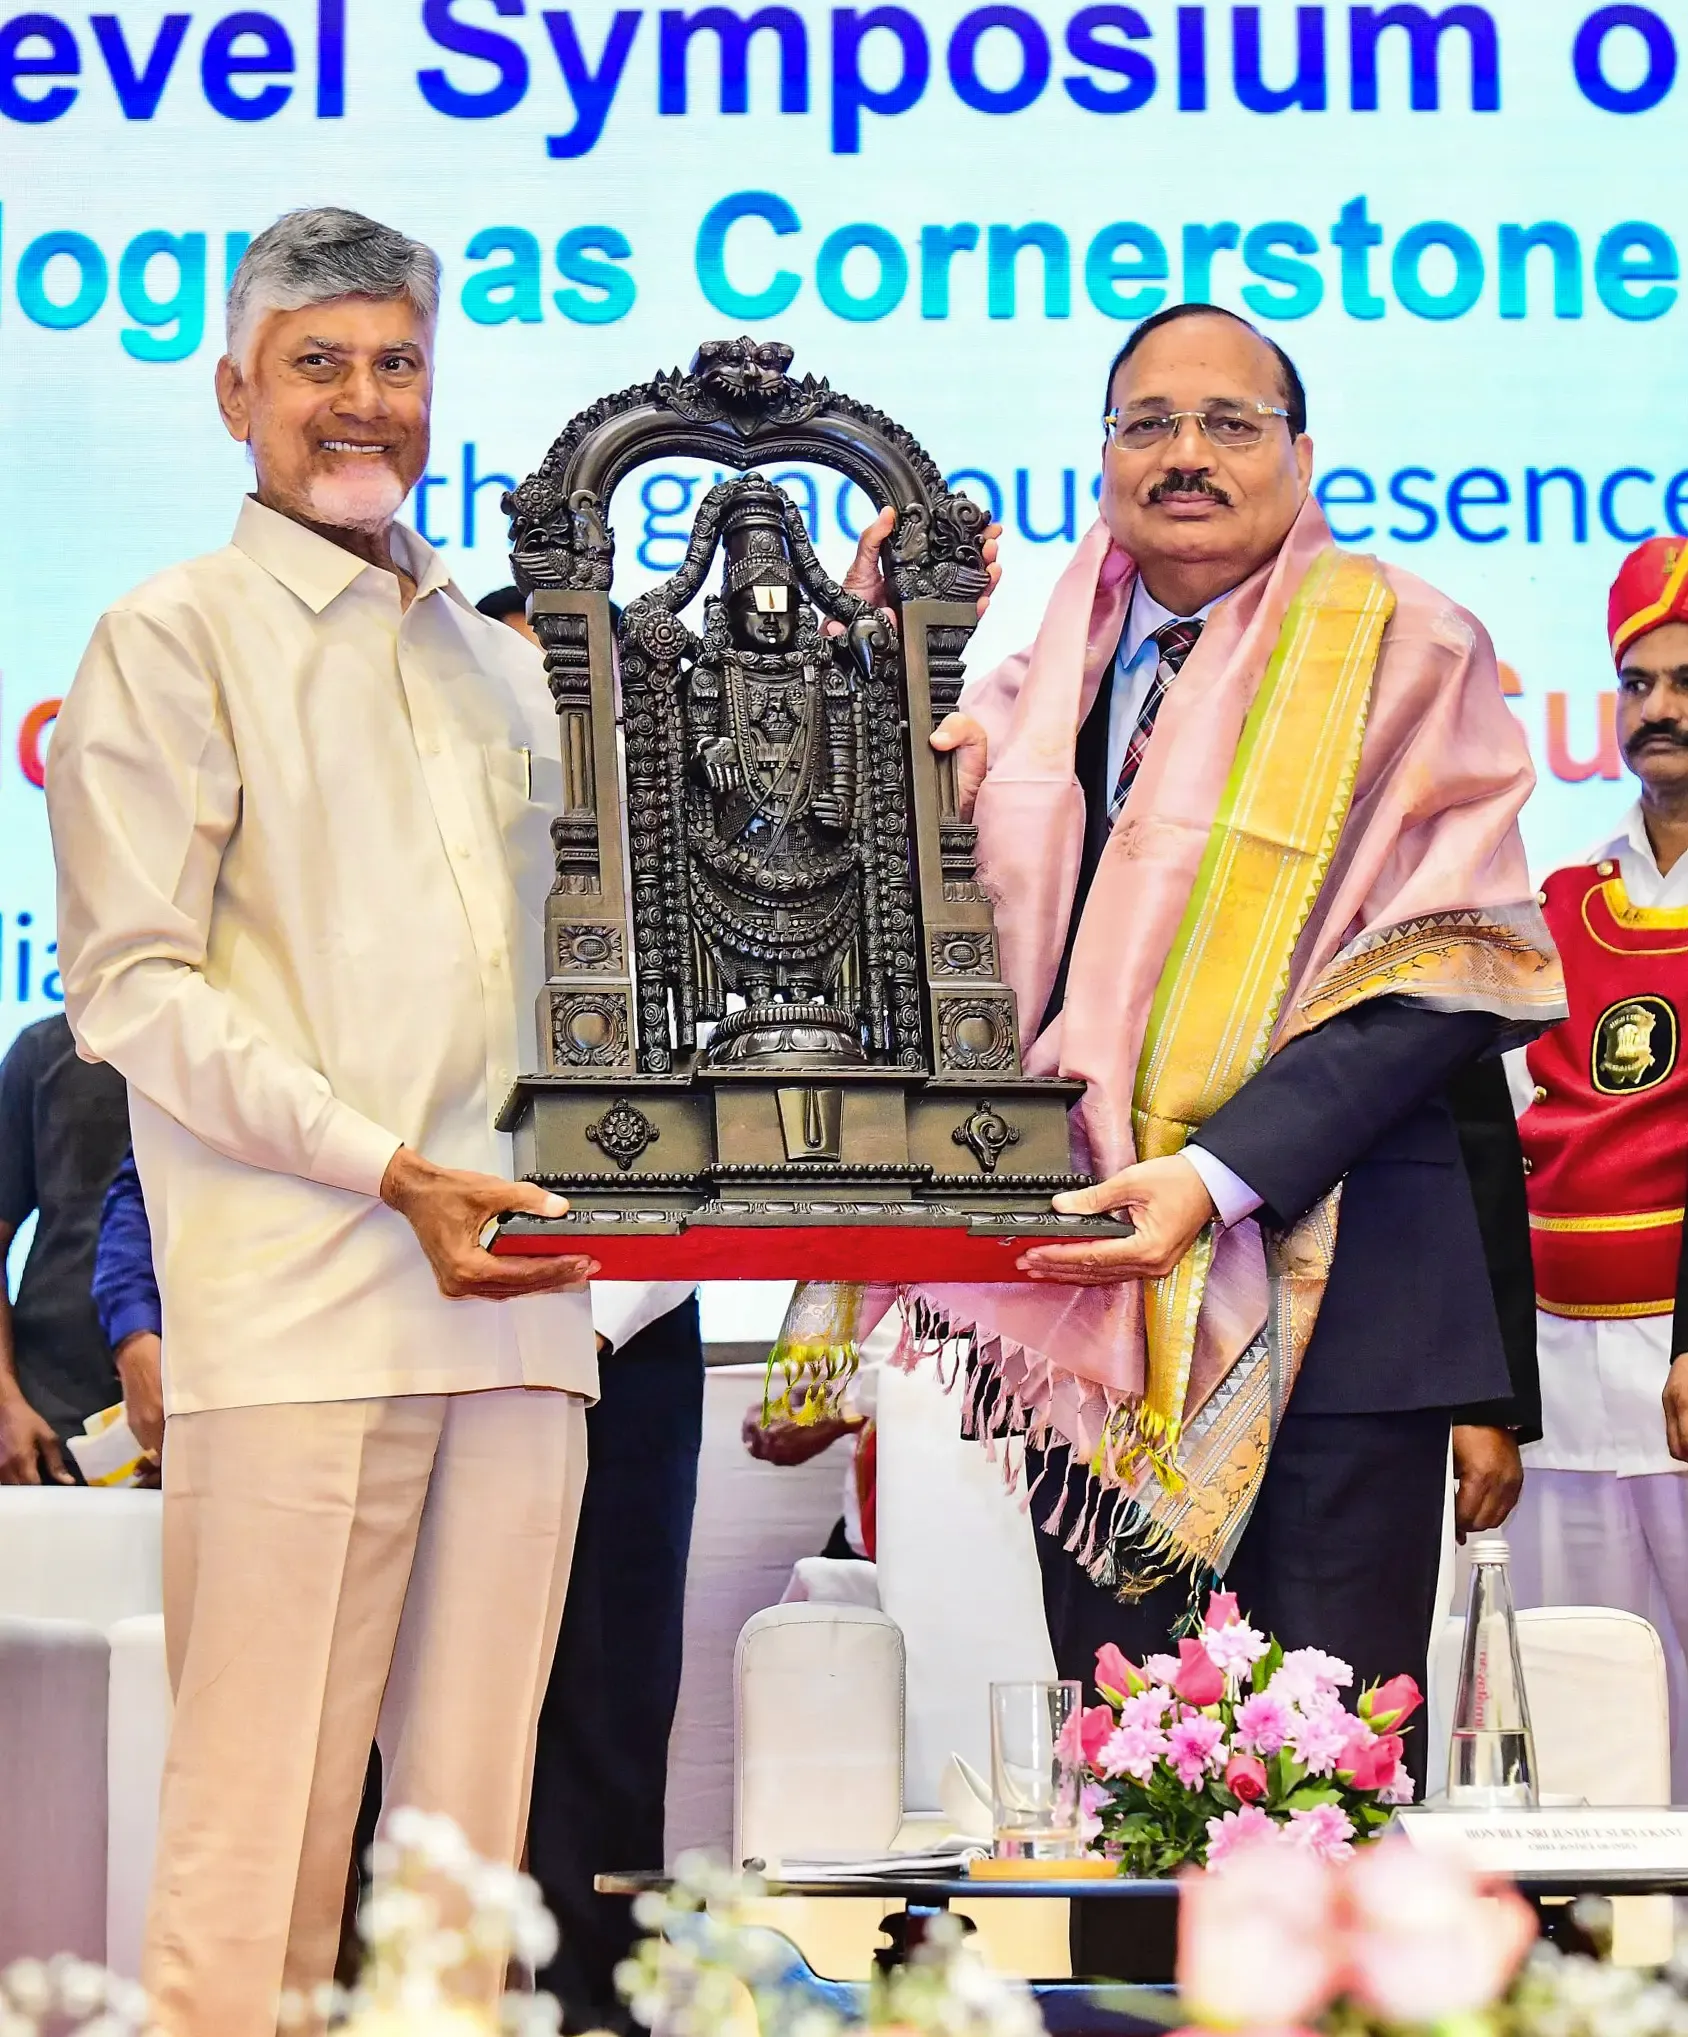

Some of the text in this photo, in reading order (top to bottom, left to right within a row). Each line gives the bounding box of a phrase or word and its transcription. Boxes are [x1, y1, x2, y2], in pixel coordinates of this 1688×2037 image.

[416, 0, 1502, 160] Symposium
[460, 224, 638, 326] as
[694, 190, 1681, 325] Cornerstone
